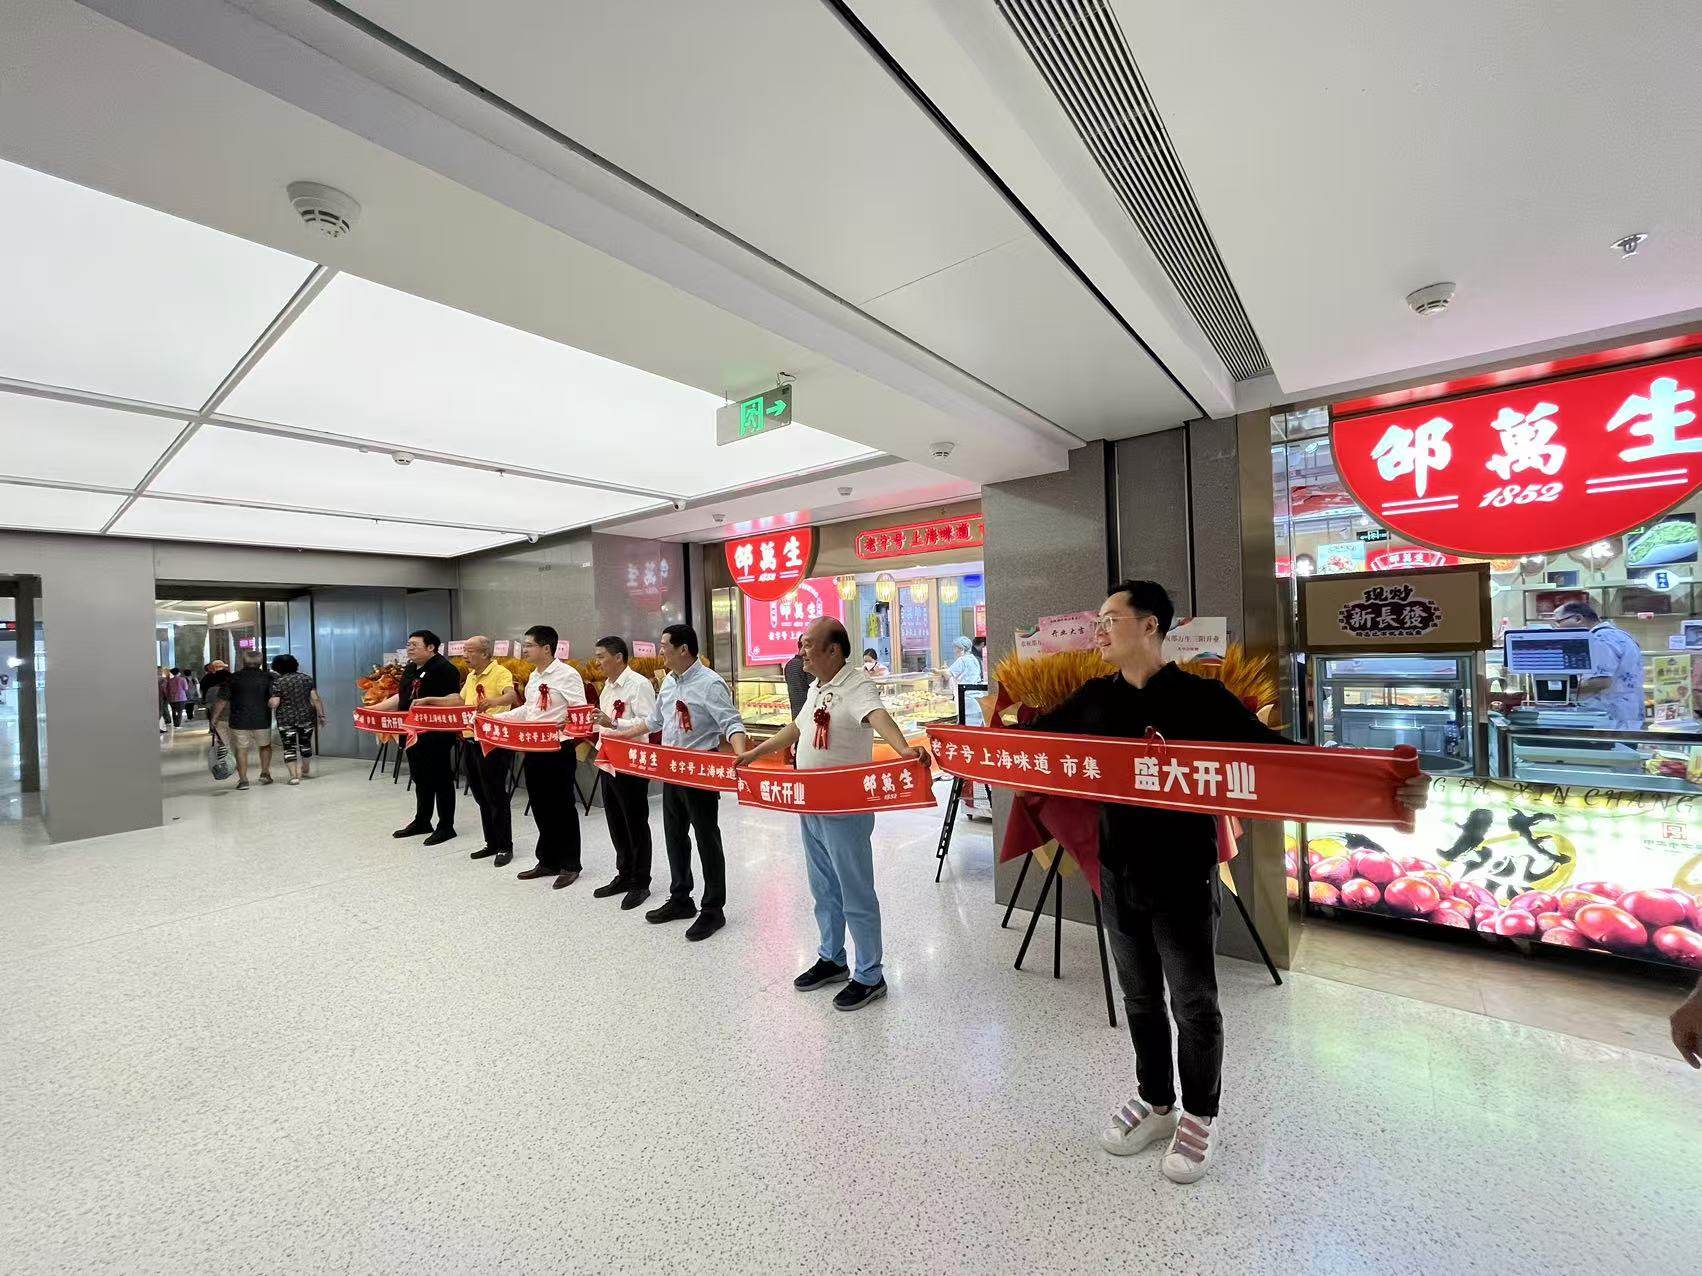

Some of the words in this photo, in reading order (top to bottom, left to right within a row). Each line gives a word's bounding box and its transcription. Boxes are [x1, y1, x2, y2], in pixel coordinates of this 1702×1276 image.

[1370, 377, 1702, 498] 邵萬生
[1479, 482, 1564, 508] 1852
[734, 535, 803, 577] 邵萬生
[1363, 584, 1413, 601] 现炒
[1350, 605, 1428, 628] 新長發
[760, 780, 806, 805] 盛大开业
[863, 768, 914, 797] 邵萬生
[1059, 754, 1102, 780] 市集
[1134, 756, 1258, 800] 盛大开业
[1584, 787, 1695, 813] CHANG
